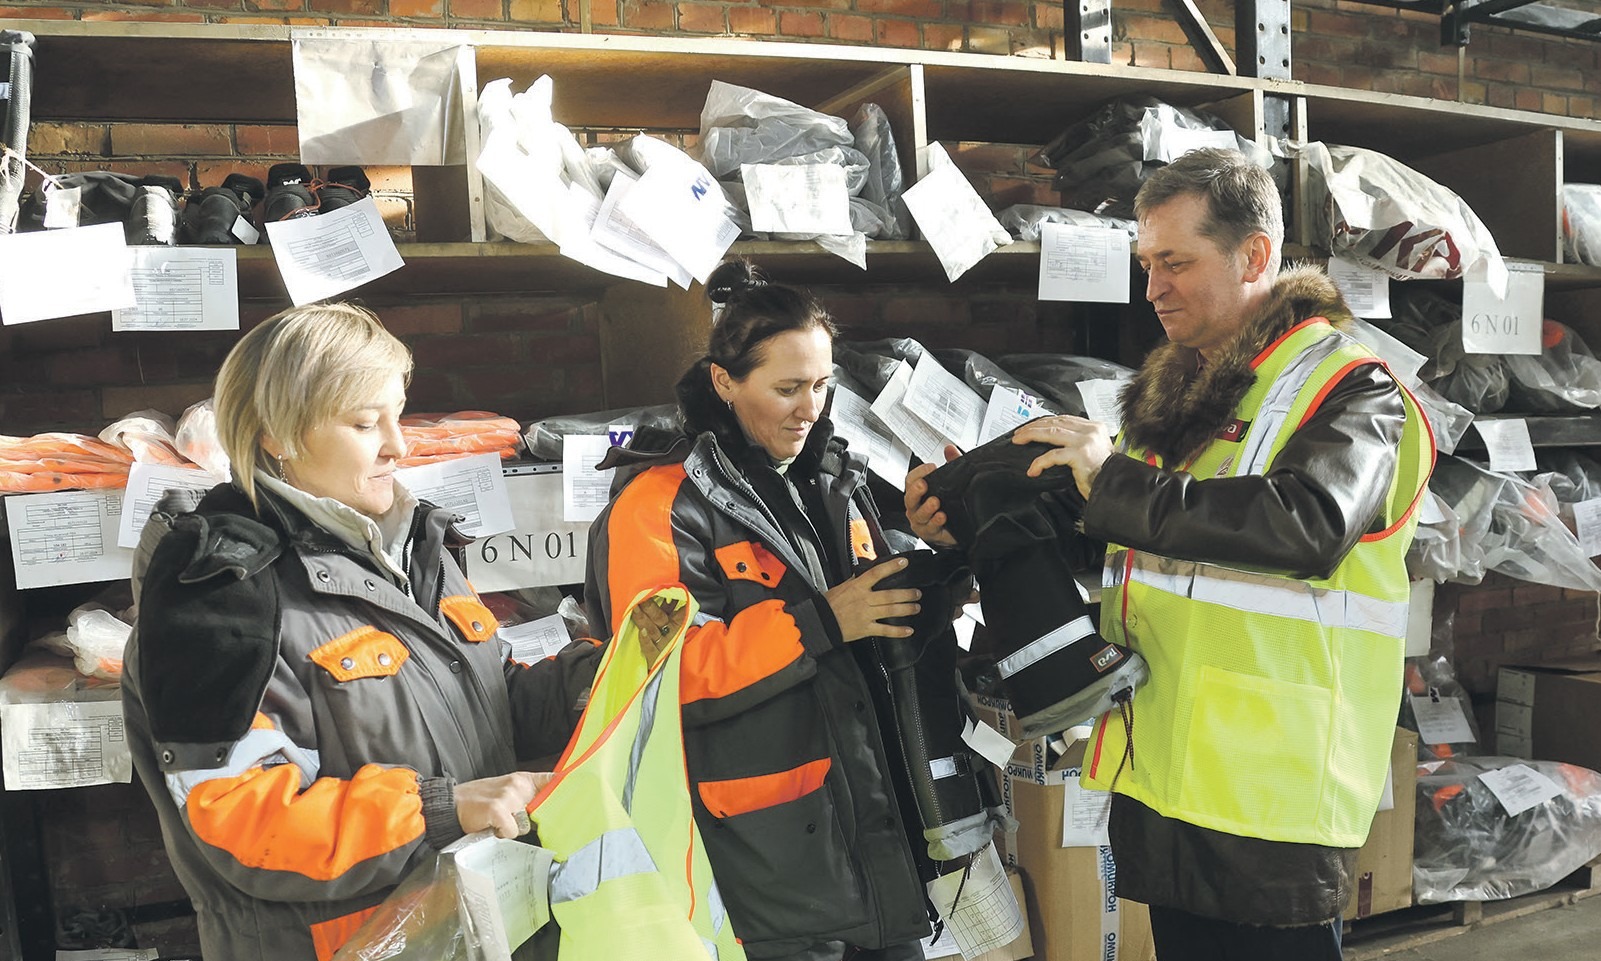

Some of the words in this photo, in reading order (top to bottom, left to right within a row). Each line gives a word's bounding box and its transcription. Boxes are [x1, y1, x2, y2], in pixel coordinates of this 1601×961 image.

[1471, 313, 1480, 335] 6
[1485, 314, 1498, 335] N
[1503, 315, 1519, 336] 01
[481, 535, 499, 564] 6
[506, 533, 535, 562] N
[544, 531, 577, 560] 01
